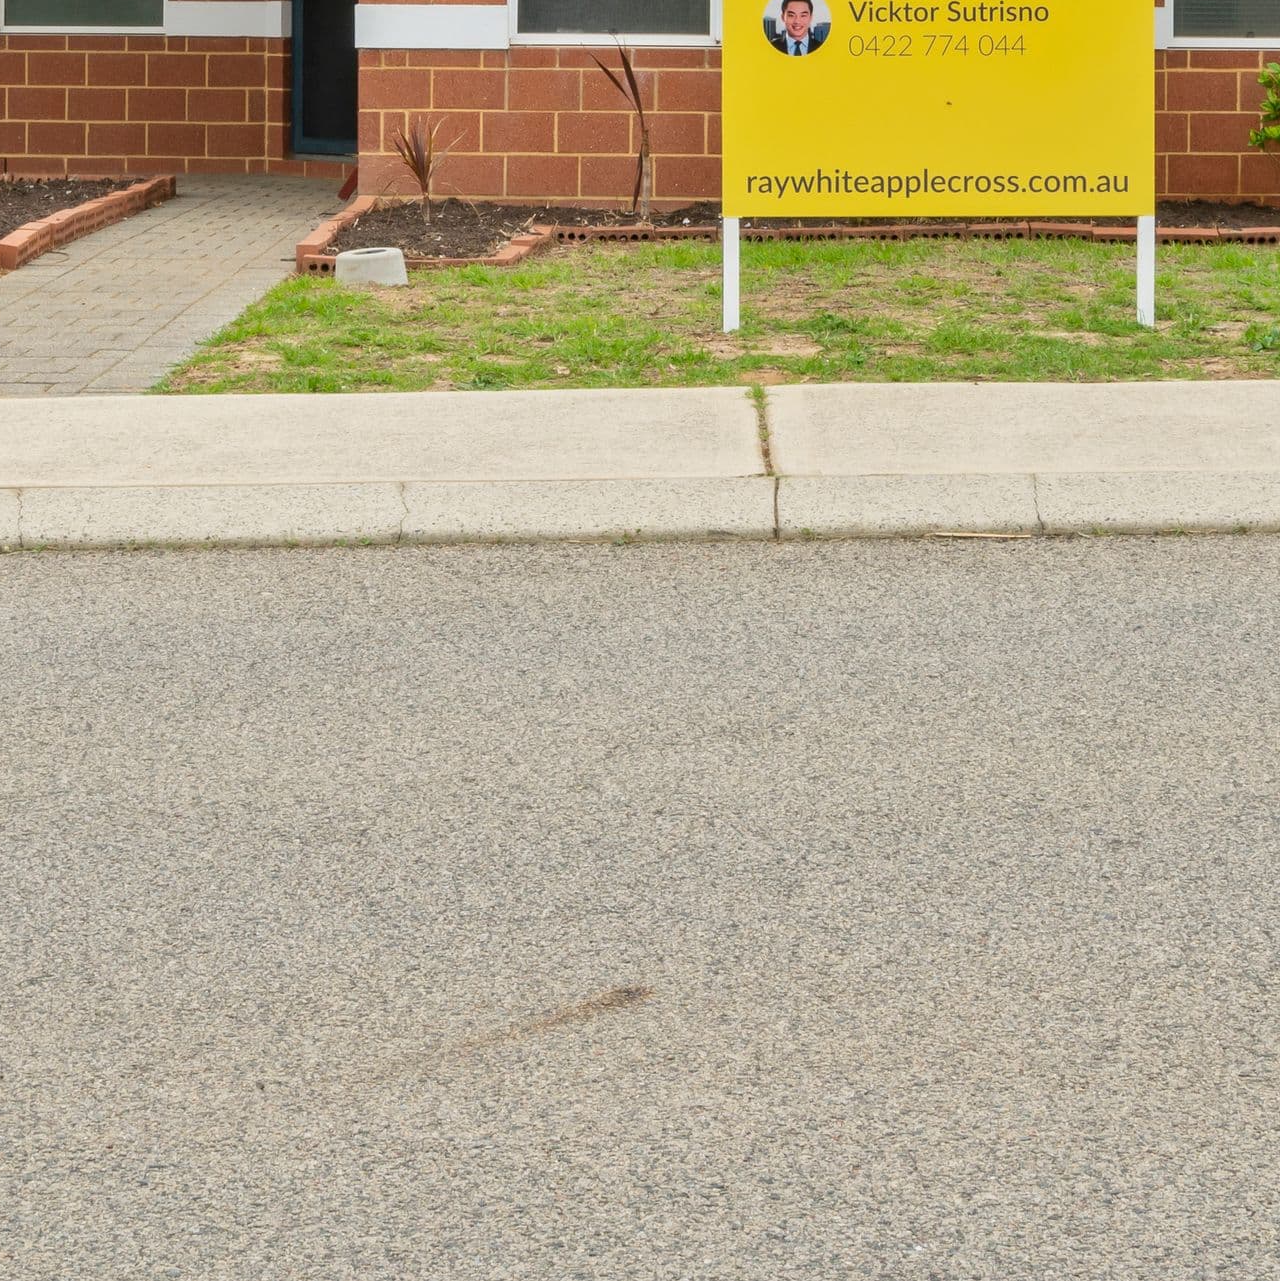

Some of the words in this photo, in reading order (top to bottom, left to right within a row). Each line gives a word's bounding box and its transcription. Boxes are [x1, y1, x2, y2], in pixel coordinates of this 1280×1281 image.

[847, 0, 940, 24] Vicktor
[946, 0, 1050, 24] Sutrisno
[847, 33, 913, 57] 0422
[921, 33, 971, 57] 774
[977, 33, 1027, 57] 044
[745, 167, 1130, 199] raywhiteapplecross.com.au
